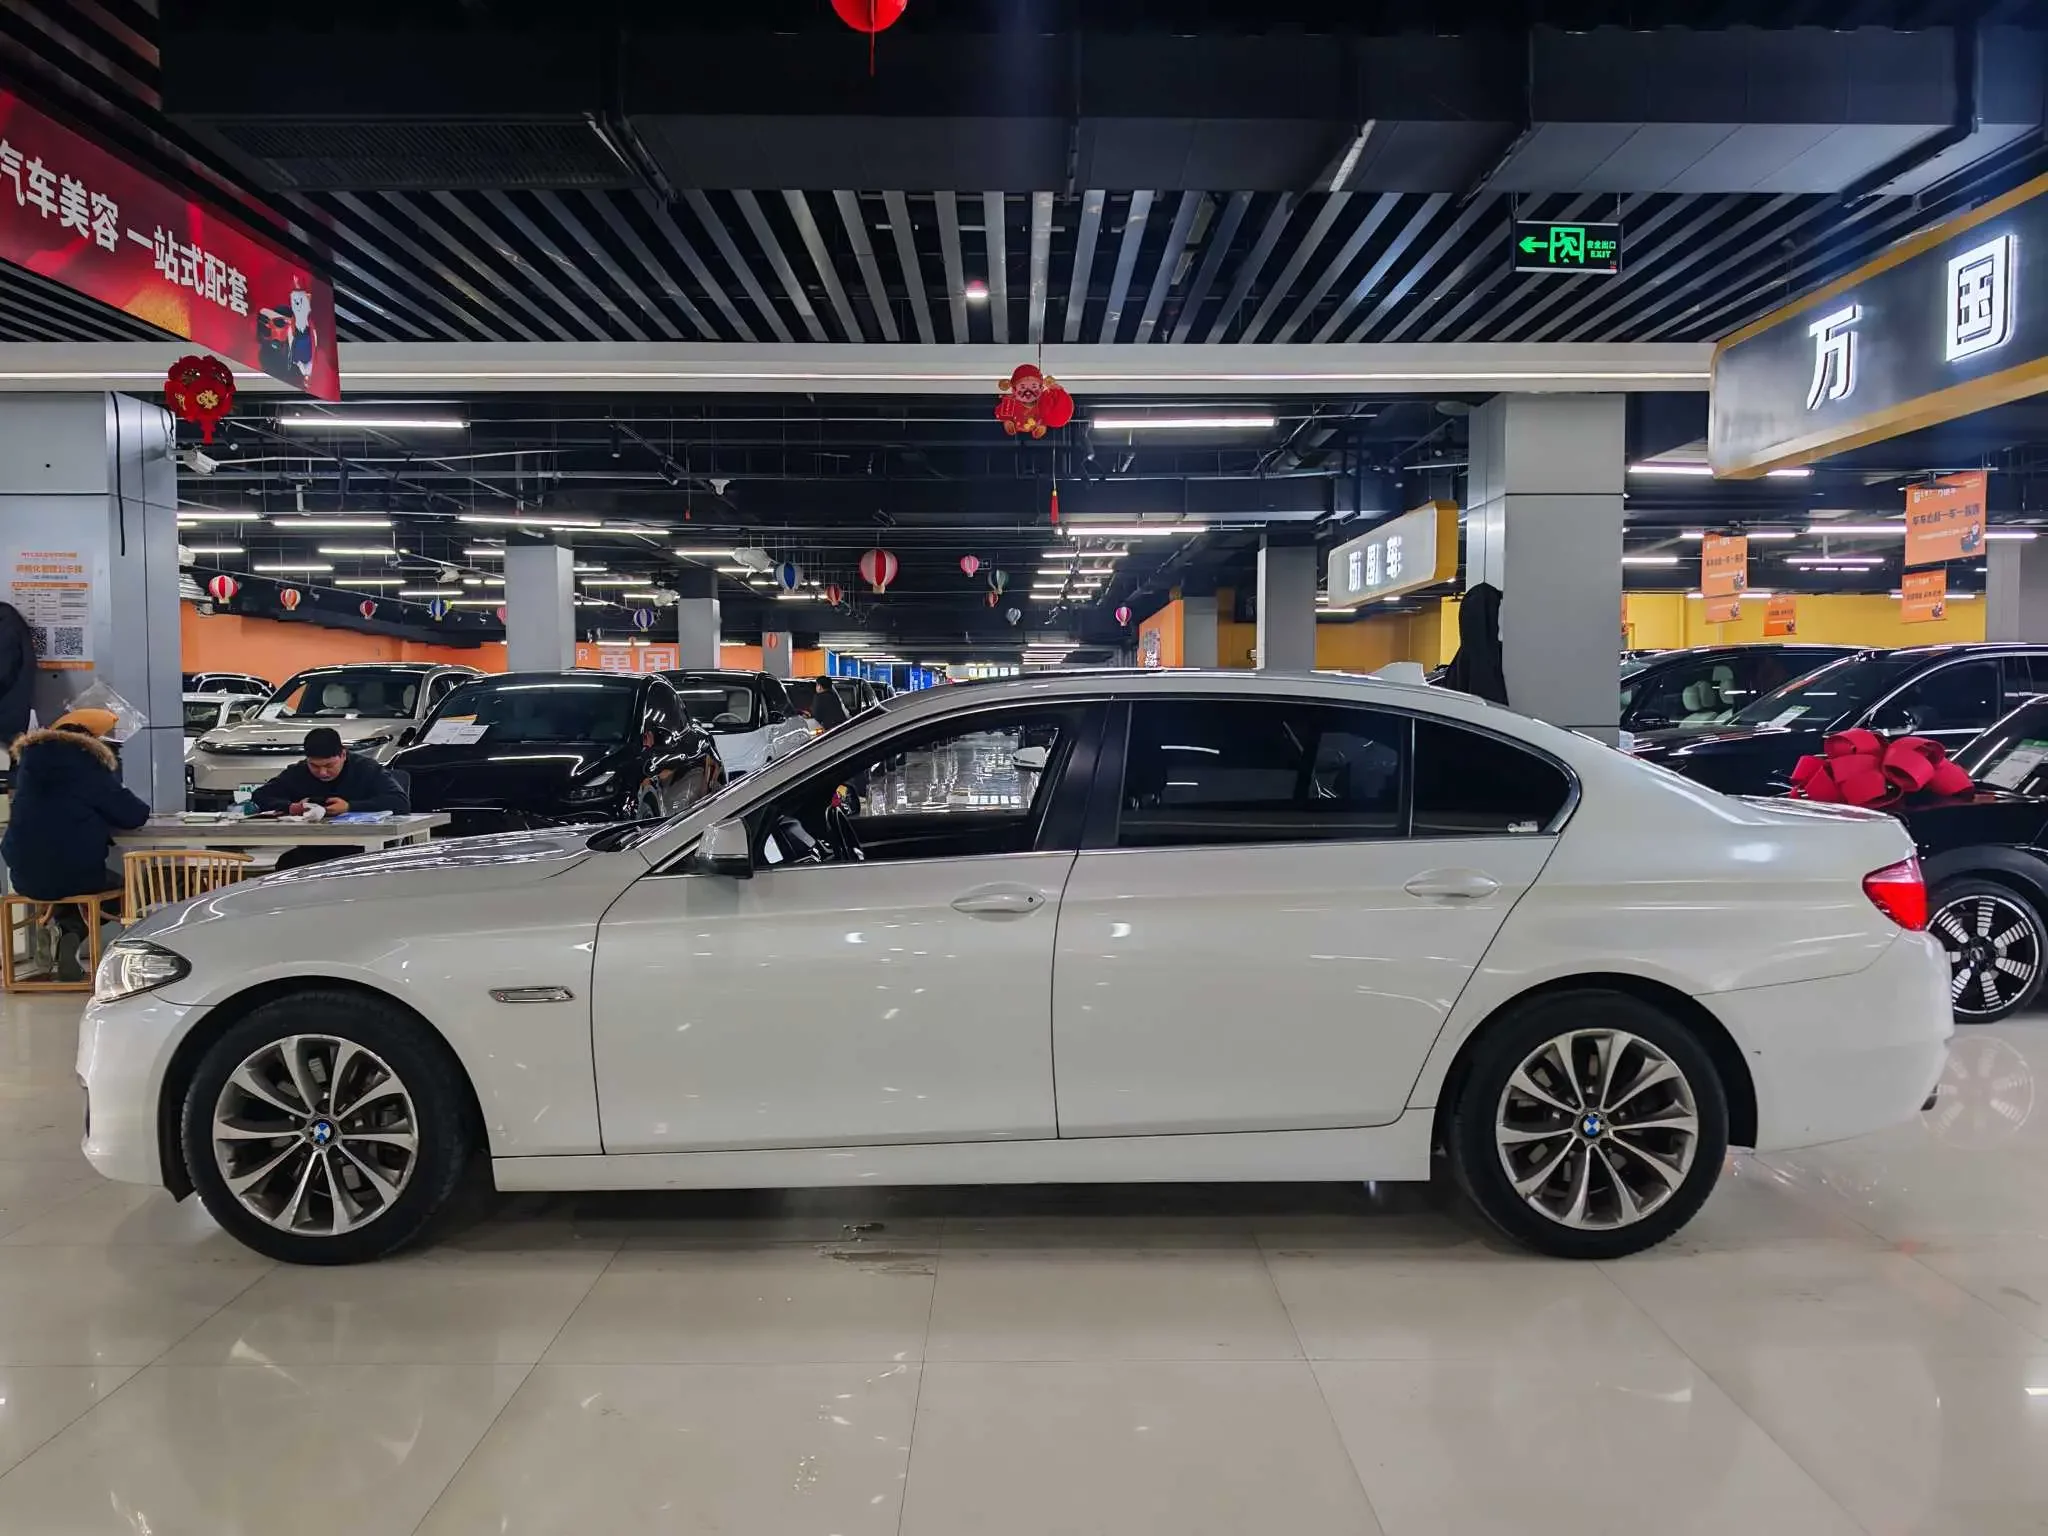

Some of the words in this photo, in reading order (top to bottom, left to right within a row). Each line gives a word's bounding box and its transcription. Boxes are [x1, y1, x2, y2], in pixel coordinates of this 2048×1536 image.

[126, 225, 249, 317] 一站式配套
